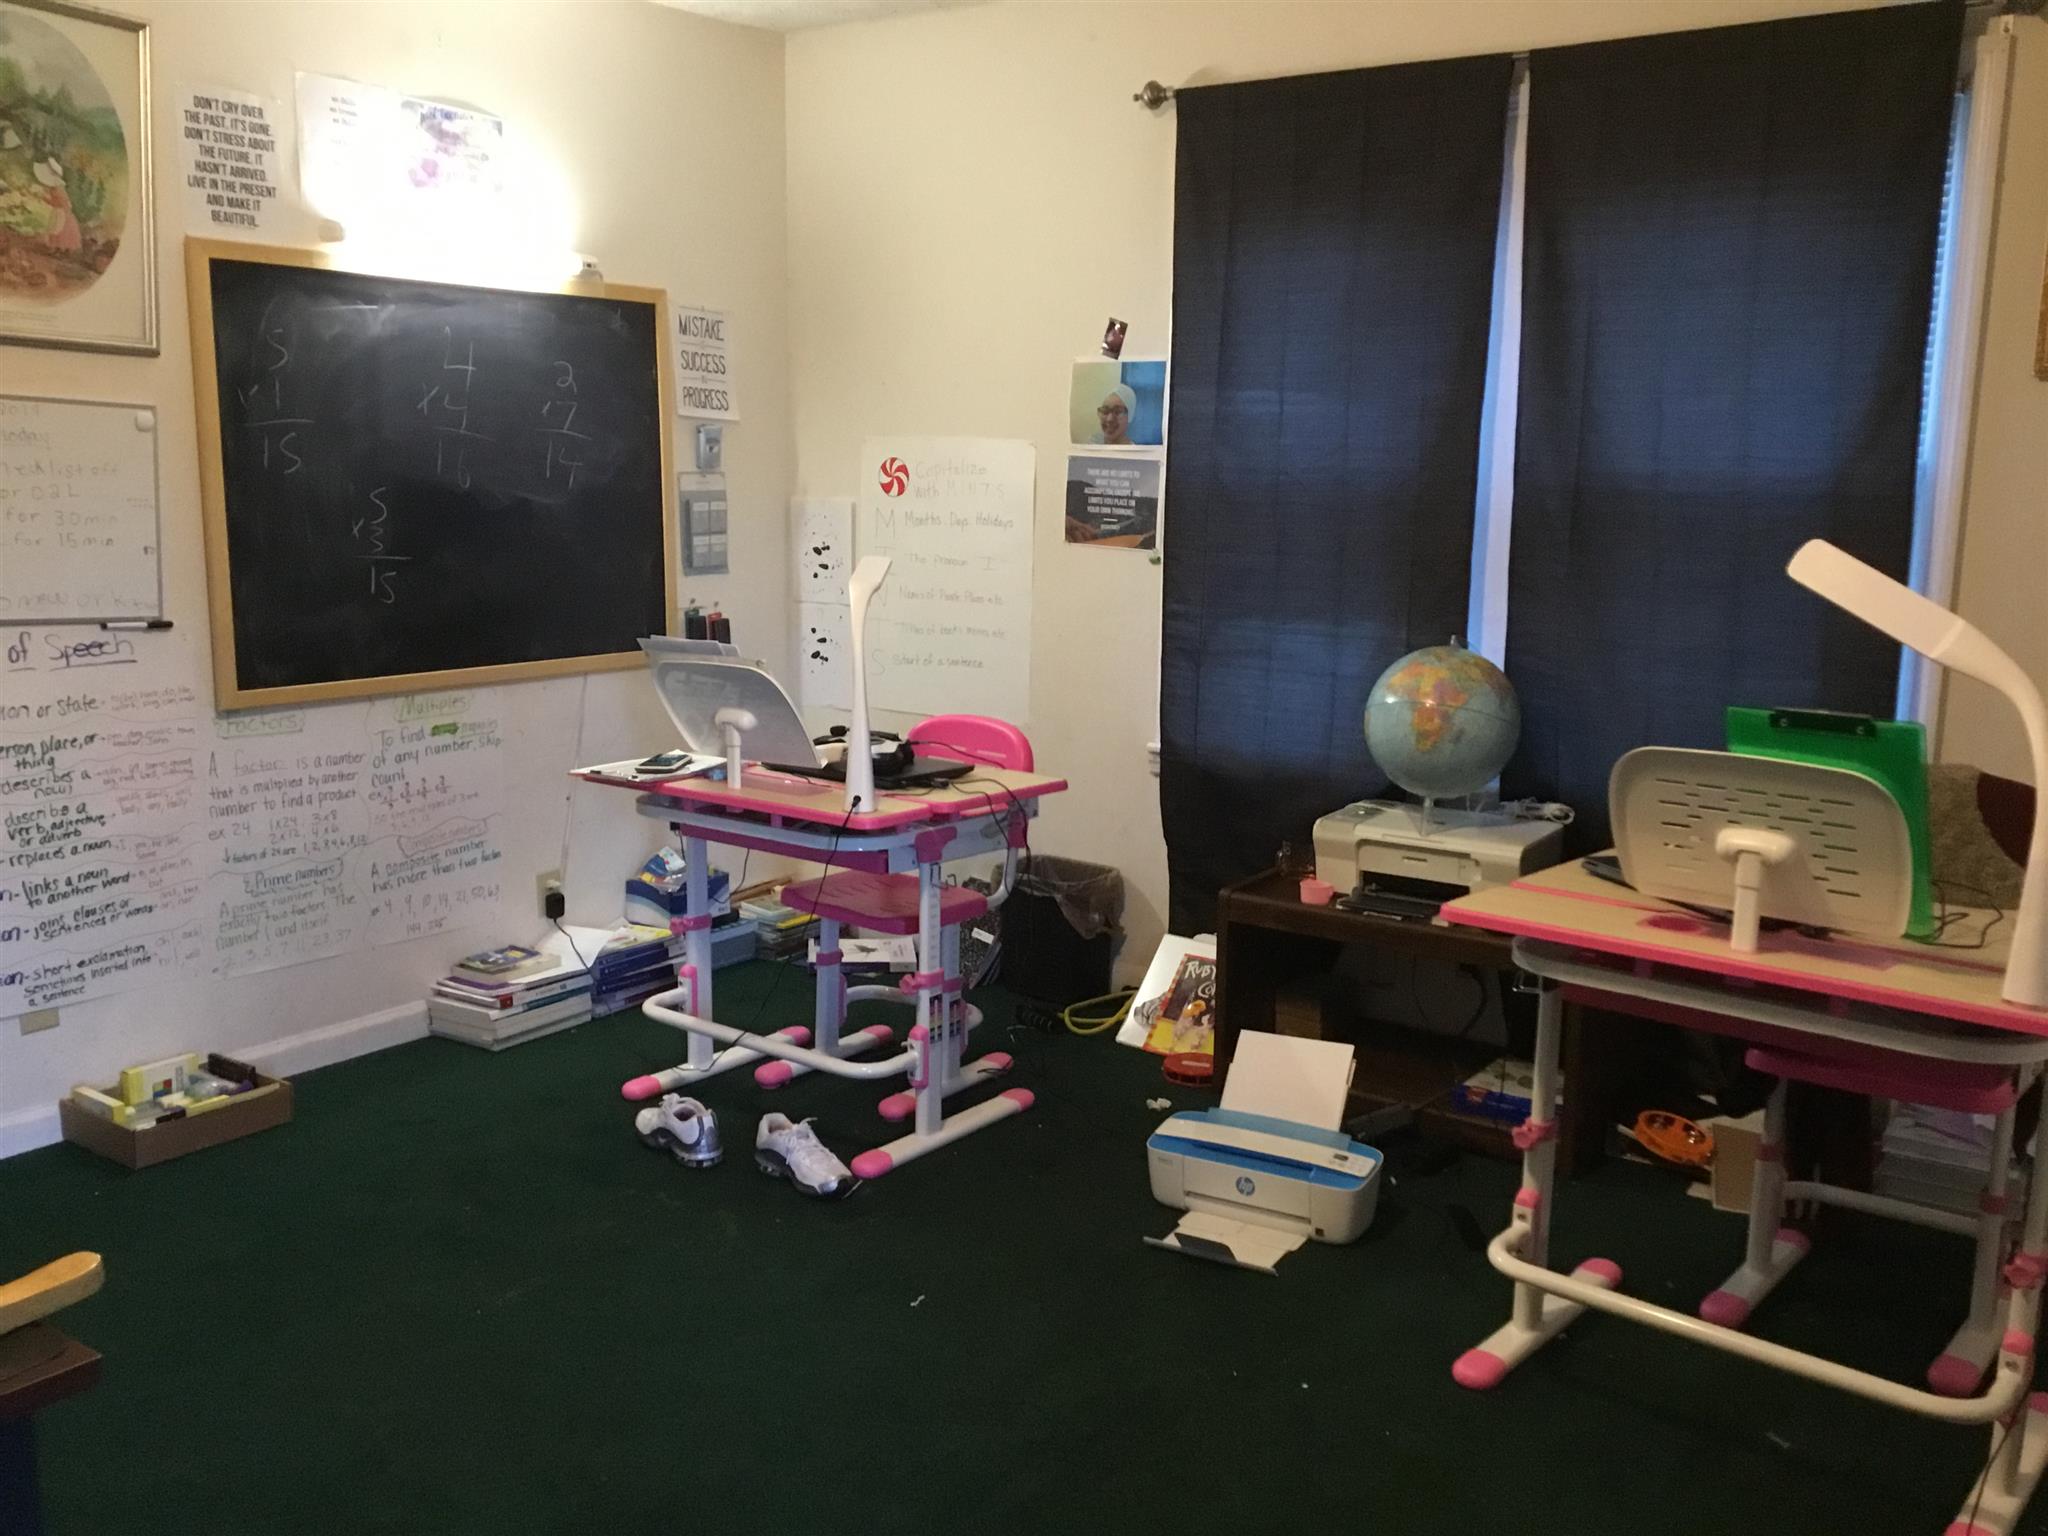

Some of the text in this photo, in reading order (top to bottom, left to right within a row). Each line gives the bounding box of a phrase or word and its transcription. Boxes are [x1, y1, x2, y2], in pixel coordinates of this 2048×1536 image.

[193, 94, 264, 119] DON'T CRY OVER
[184, 109, 202, 125] THE
[230, 118, 247, 132] IT'S
[184, 126, 275, 152] DON'T STRESS ABOUT
[199, 145, 216, 160] THE
[254, 152, 263, 166] IT
[194, 160, 227, 177] HASN'T
[187, 173, 277, 198] LIVE IN THE PRESENT
[206, 193, 261, 212] AND MAKE IT
[678, 313, 724, 342] MISTAKE
[443, 326, 477, 392] 4
[681, 349, 726, 375] SUCCESS
[553, 360, 578, 394] 2
[682, 386, 729, 411] PROGRESS
[437, 438, 471, 489] 16
[546, 439, 584, 490] 14
[371, 564, 397, 604] 15
[7, 631, 135, 668] of Speech
[36, 704, 51, 719] or
[57, 694, 99, 716] state
[400, 725, 426, 743] find
[14, 756, 56, 772] thing
[208, 751, 219, 777] A
[233, 748, 287, 776] factor
[296, 759, 309, 770] is
[313, 756, 323, 768] a
[325, 751, 366, 767] number
[372, 749, 420, 769] of any
[80, 769, 92, 780] a
[208, 785, 234, 801] that
[253, 777, 303, 793] multiplied
[308, 774, 320, 787] by
[321, 769, 359, 784] another
[371, 767, 406, 788] count
[76, 801, 88, 815] a
[208, 788, 357, 819] number to find a product
[232, 821, 251, 836] 24
[9, 847, 66, 868] replaces
[371, 861, 380, 878] A
[444, 840, 487, 857] number
[432, 863, 455, 876] than
[21, 877, 60, 902] links
[64, 876, 74, 887] a
[78, 867, 109, 883] noun
[47, 885, 98, 905] another
[101, 871, 131, 889] word
[255, 865, 336, 889] Prime numbers
[73, 901, 117, 920] clauses
[119, 897, 132, 909] or
[125, 904, 153, 919] words
[219, 901, 230, 918] A
[272, 889, 313, 906] number
[335, 894, 357, 907] The
[215, 927, 260, 951] number
[274, 921, 298, 938] and
[32, 960, 73, 981] short
[42, 985, 87, 1004] sentence
[1197, 981, 1216, 998] Co
[1237, 1177, 1254, 1196] hp
